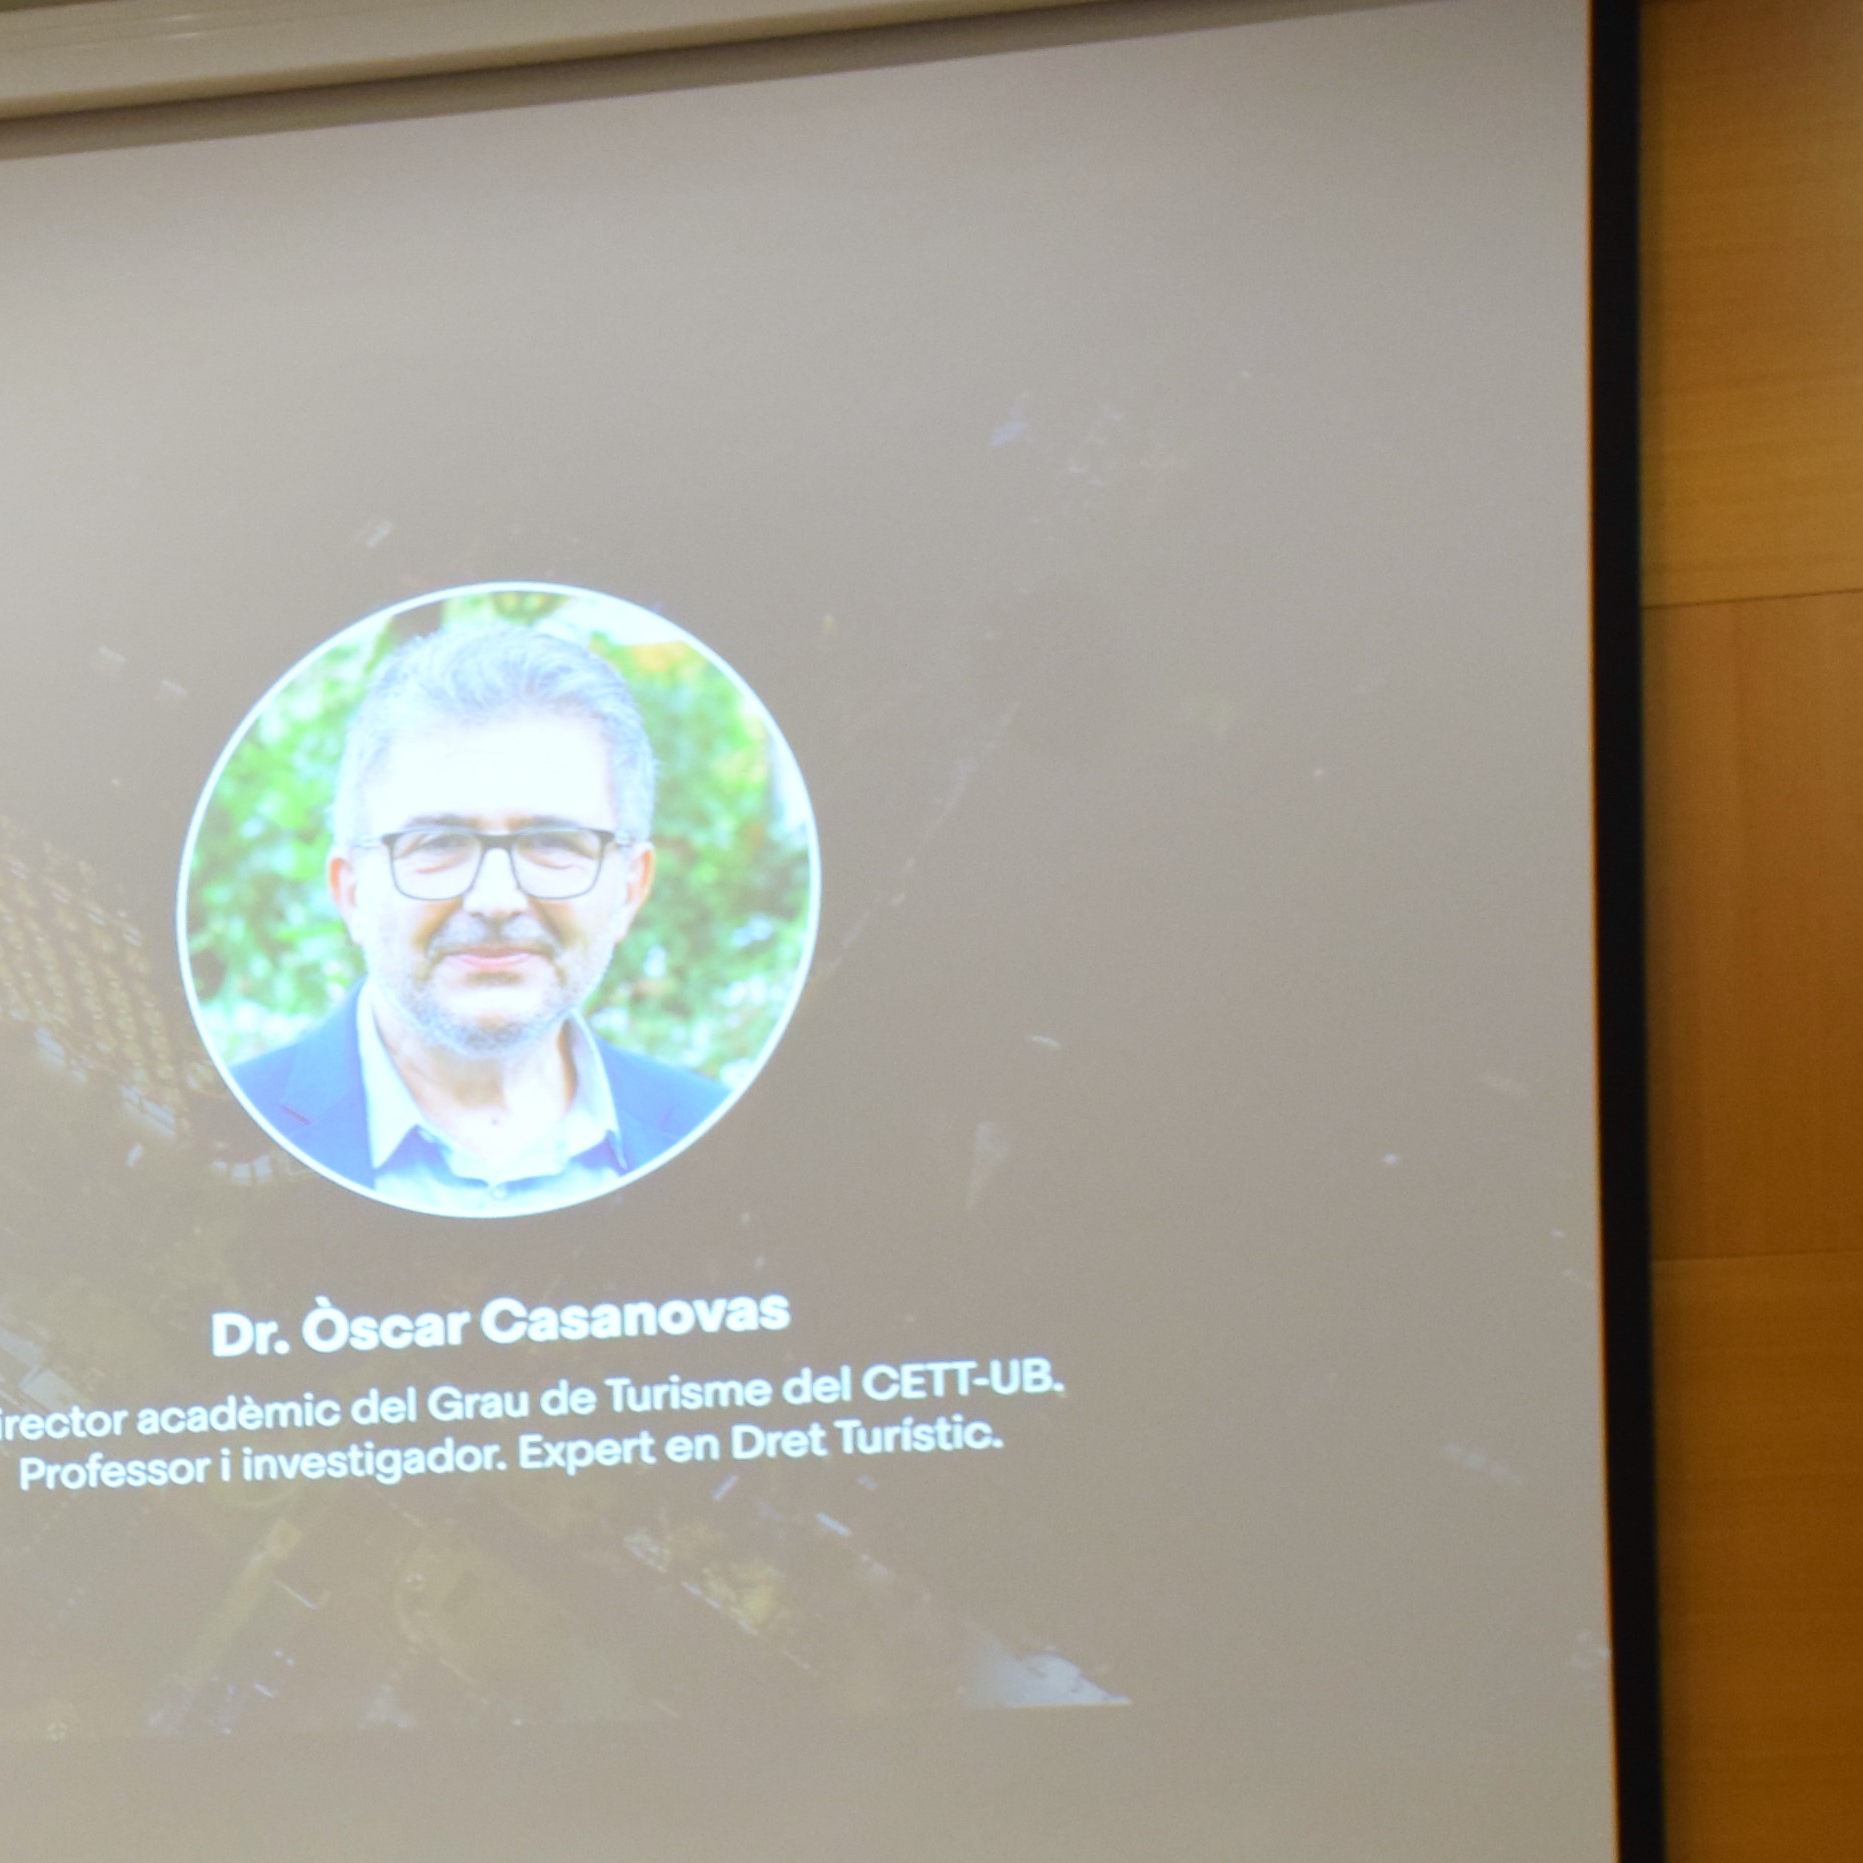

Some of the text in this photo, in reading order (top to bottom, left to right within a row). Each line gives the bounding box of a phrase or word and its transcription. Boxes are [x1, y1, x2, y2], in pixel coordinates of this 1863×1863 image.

[211, 1294, 791, 1357] Dr. Òscar Casanovas
[136, 1392, 341, 1434] acadèmic
[350, 1385, 418, 1426] del
[427, 1384, 530, 1422] Grau
[540, 1379, 597, 1416] de
[604, 1373, 773, 1413] Turisme
[781, 1365, 852, 1405] del
[861, 1355, 1065, 1401] CETT-UB.
[19, 1412, 1005, 1491] Professor i investigador. Expert en Dret Turístic.
